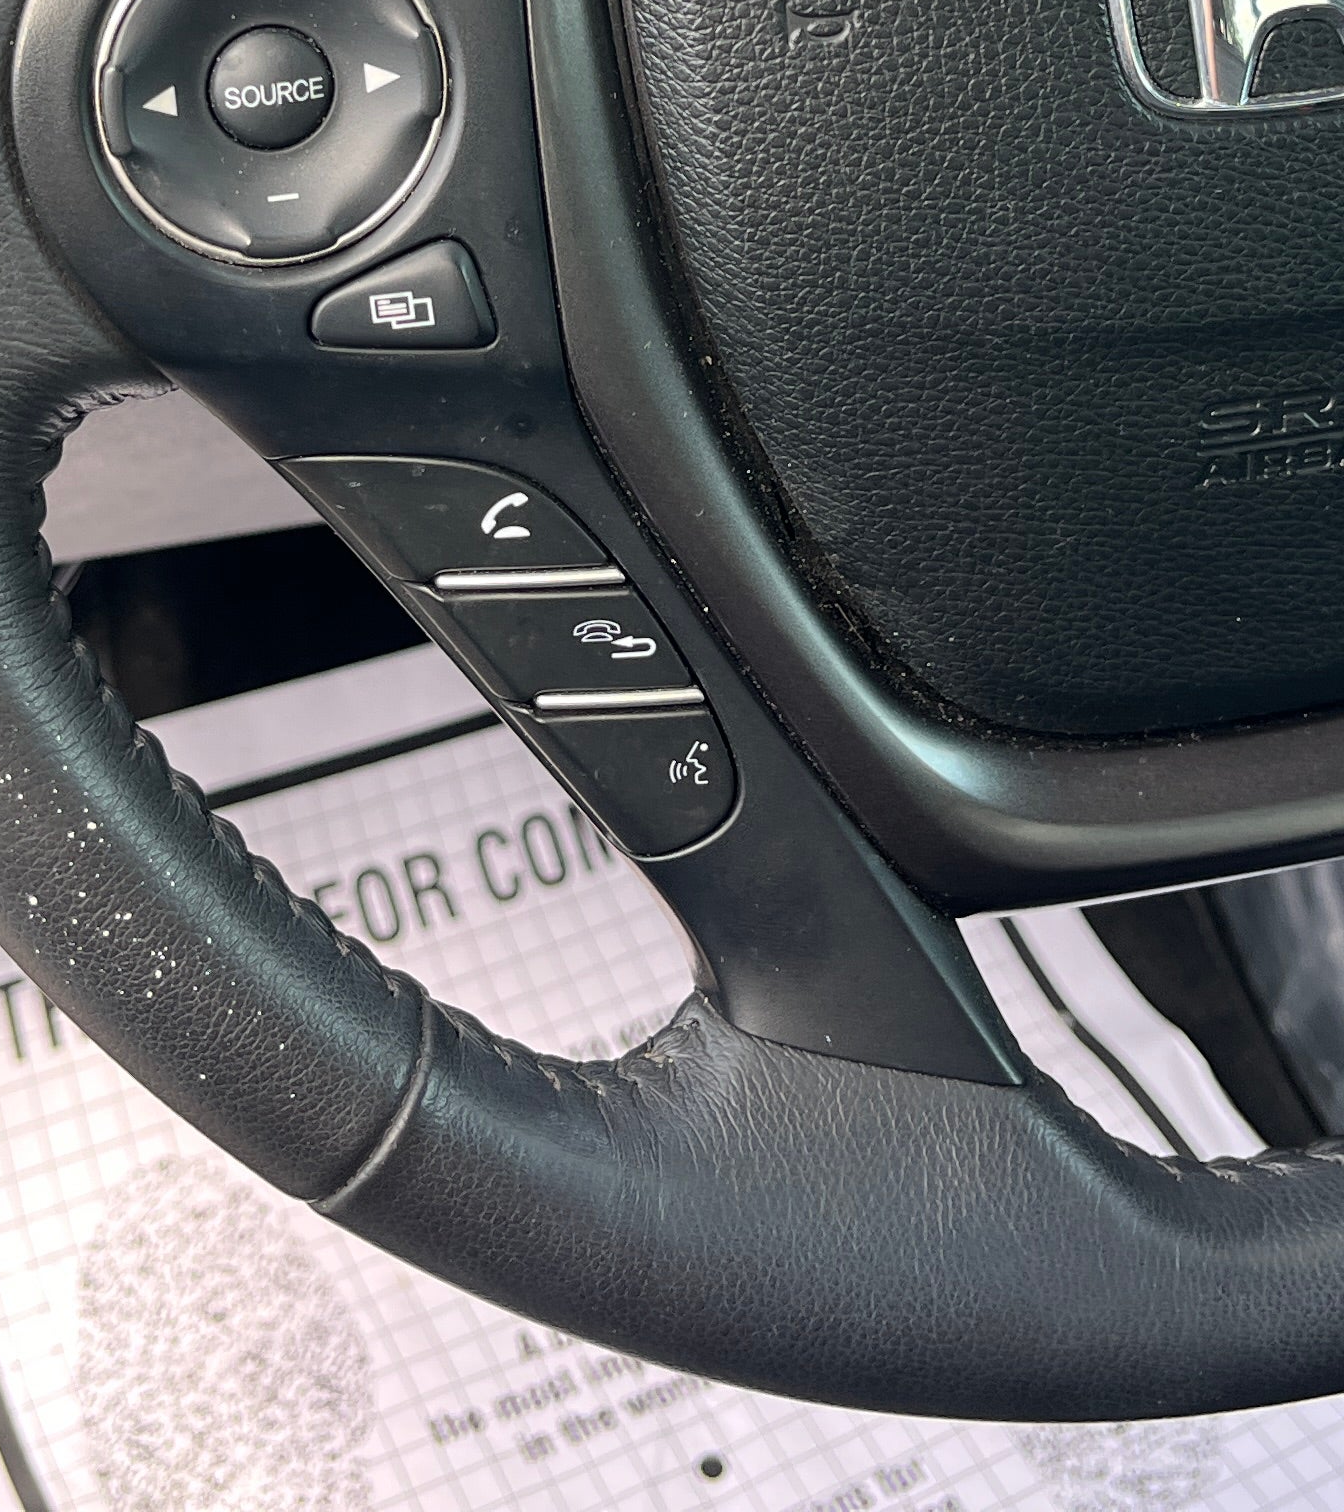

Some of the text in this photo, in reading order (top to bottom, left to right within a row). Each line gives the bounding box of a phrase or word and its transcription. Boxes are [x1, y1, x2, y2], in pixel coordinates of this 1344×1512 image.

[223, 76, 325, 110] SOURCE
[314, 853, 458, 942] FOR
[428, 1408, 486, 1446] the
[560, 1407, 619, 1446] the
